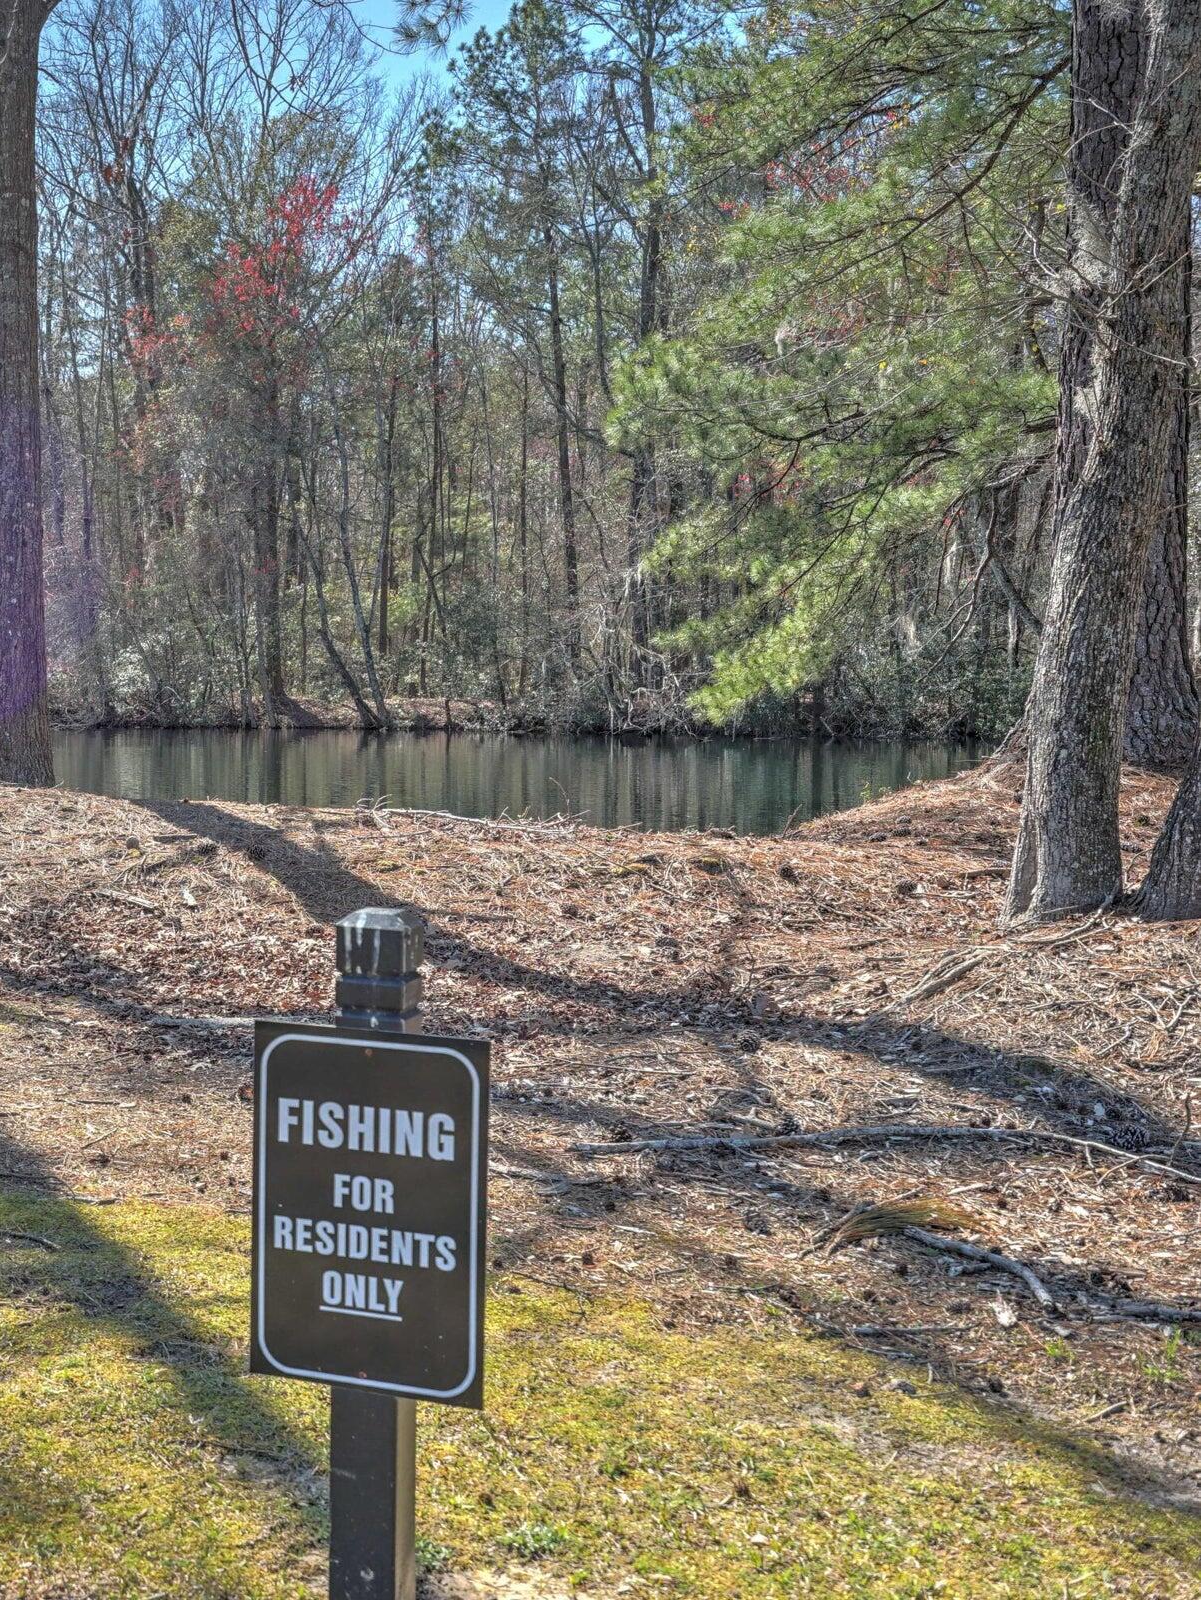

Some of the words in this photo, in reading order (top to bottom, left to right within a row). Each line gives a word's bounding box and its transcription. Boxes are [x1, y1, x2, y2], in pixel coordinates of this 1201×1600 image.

[277, 1097, 455, 1162] FISHING
[333, 1173, 395, 1215] FOR
[273, 1215, 457, 1272] RESIDENTS
[322, 1270, 404, 1314] ONLY
